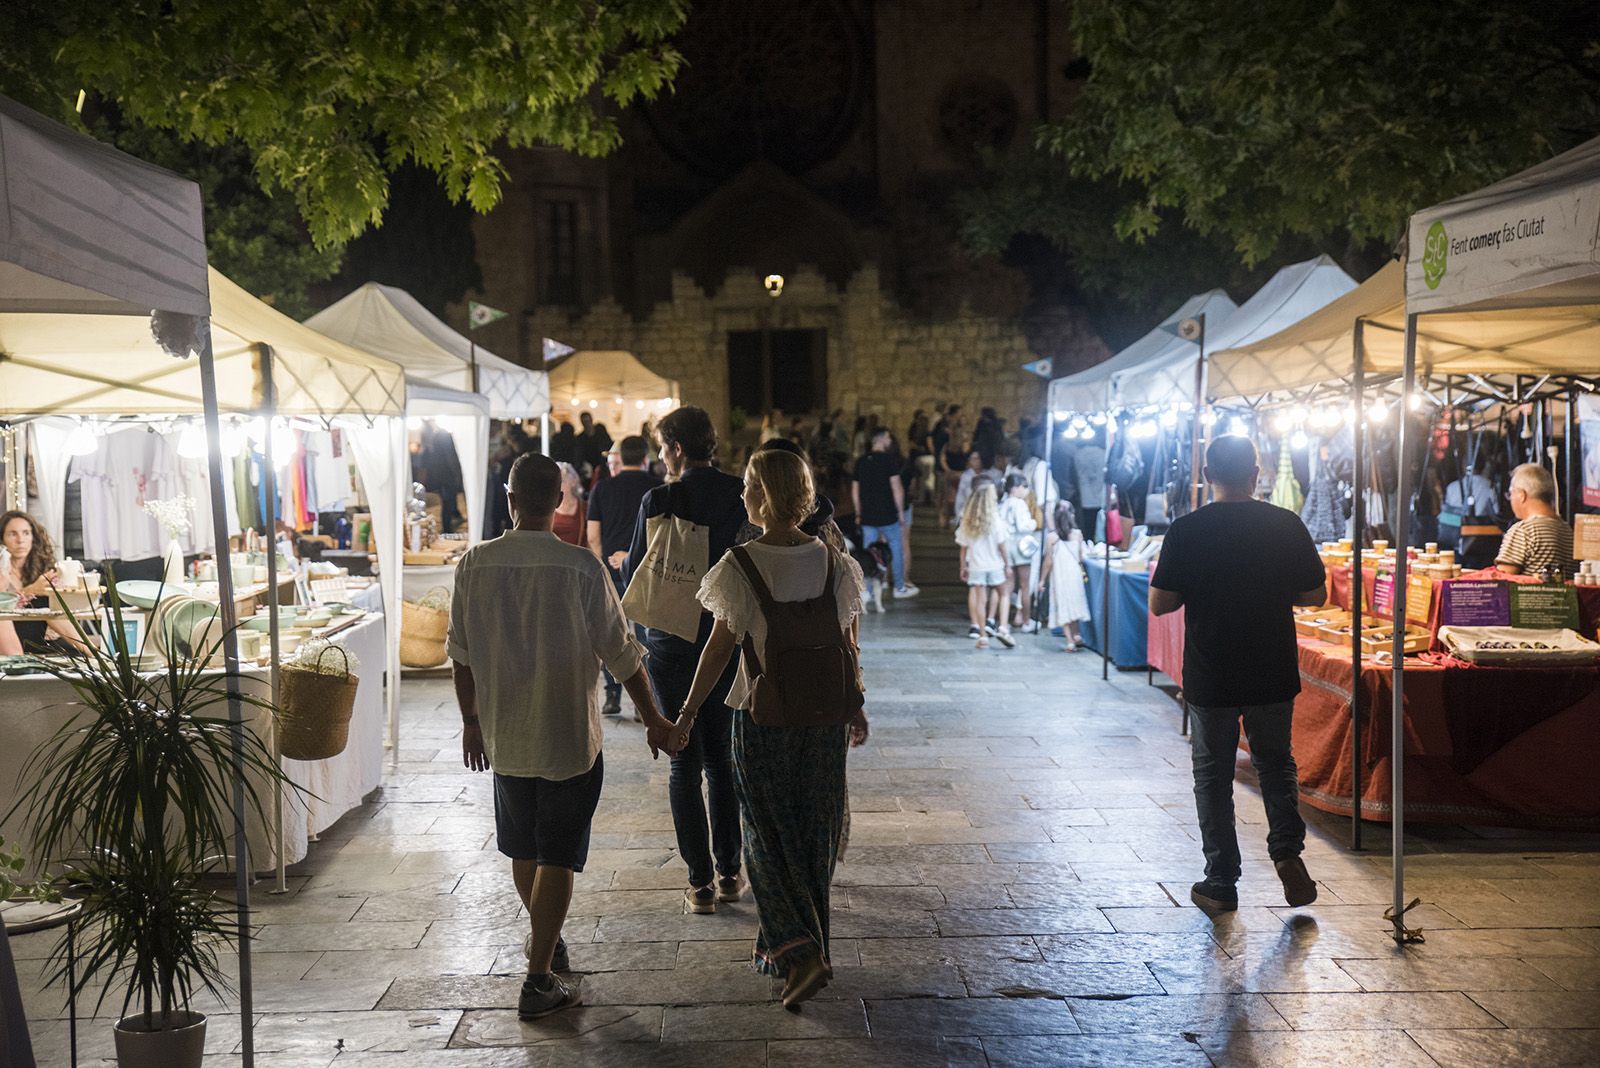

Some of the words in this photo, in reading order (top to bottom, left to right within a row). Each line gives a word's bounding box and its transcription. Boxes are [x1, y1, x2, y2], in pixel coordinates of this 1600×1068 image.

[1451, 238, 1468, 256] Fent
[1469, 230, 1501, 250] comerç
[1503, 222, 1515, 244] fas
[1517, 216, 1545, 240] Ciutat
[648, 551, 696, 576] CAMA
